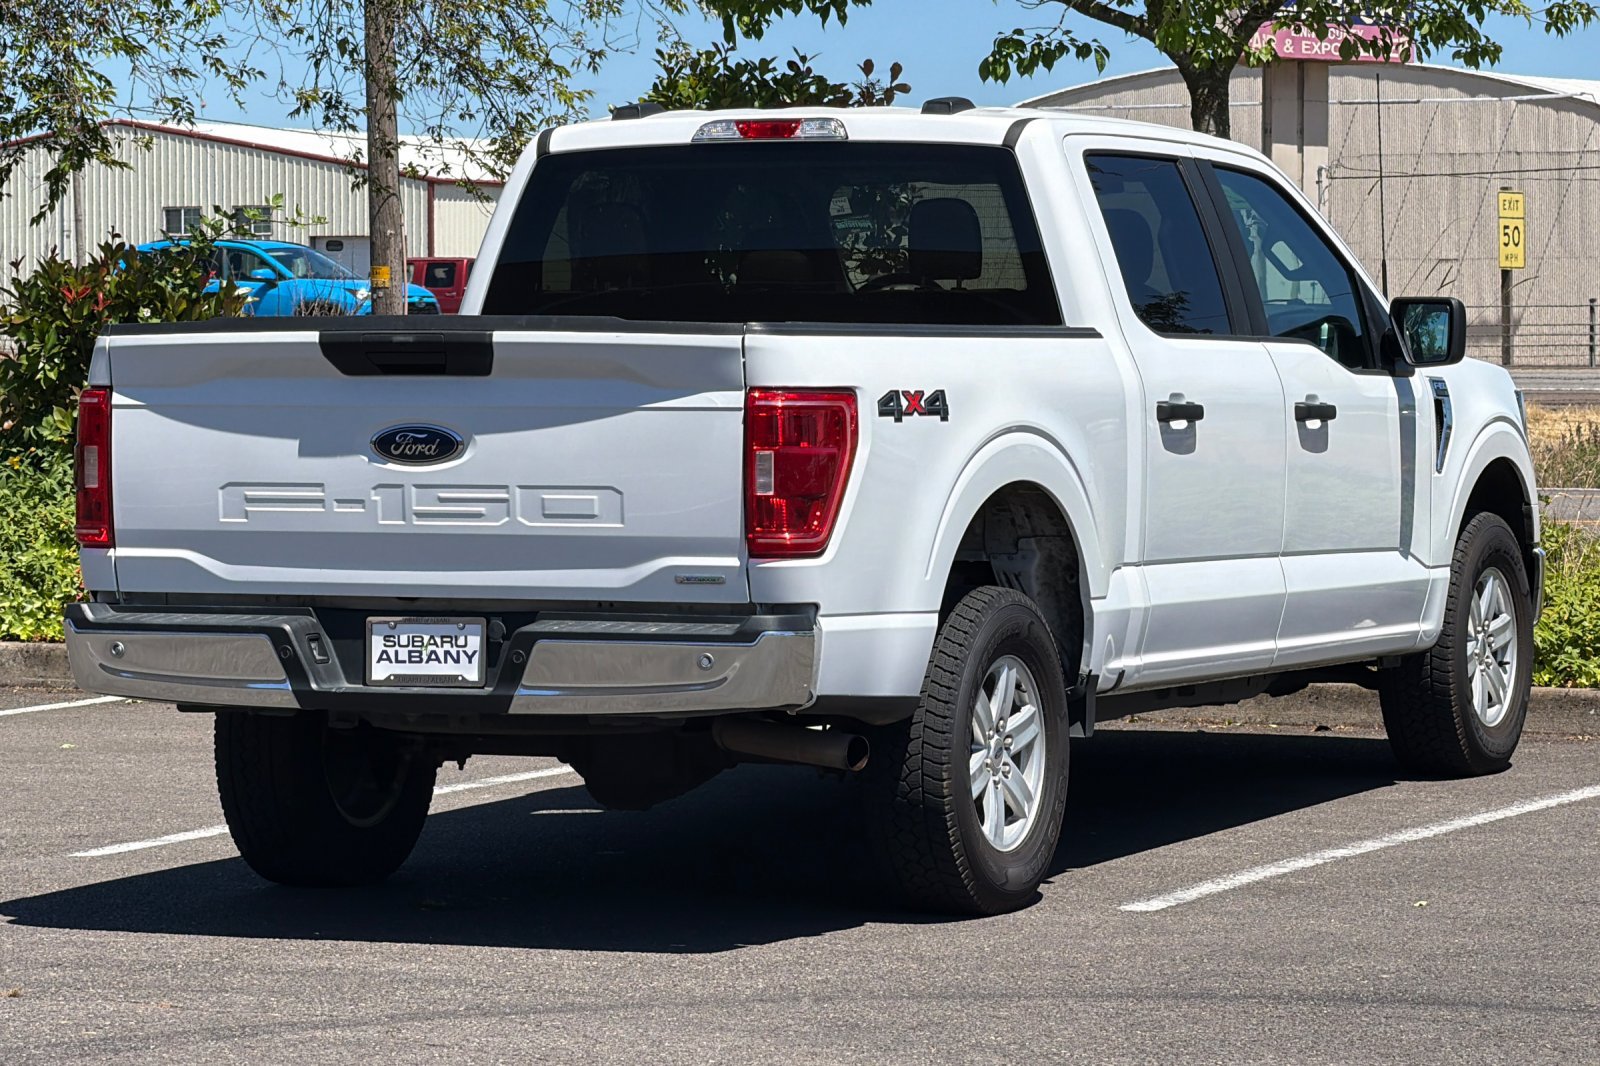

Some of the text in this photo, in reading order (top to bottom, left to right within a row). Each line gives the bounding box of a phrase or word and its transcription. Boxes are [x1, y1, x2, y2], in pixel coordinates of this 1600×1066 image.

[1283, 38, 1294, 54] &
[1502, 199, 1520, 211] EXIT
[1503, 225, 1520, 247] 50
[1504, 253, 1519, 262] MPH
[391, 432, 440, 455] Ford
[219, 482, 624, 529] F-150
[383, 635, 468, 648] SUBARU
[376, 650, 478, 664] ALBANY
